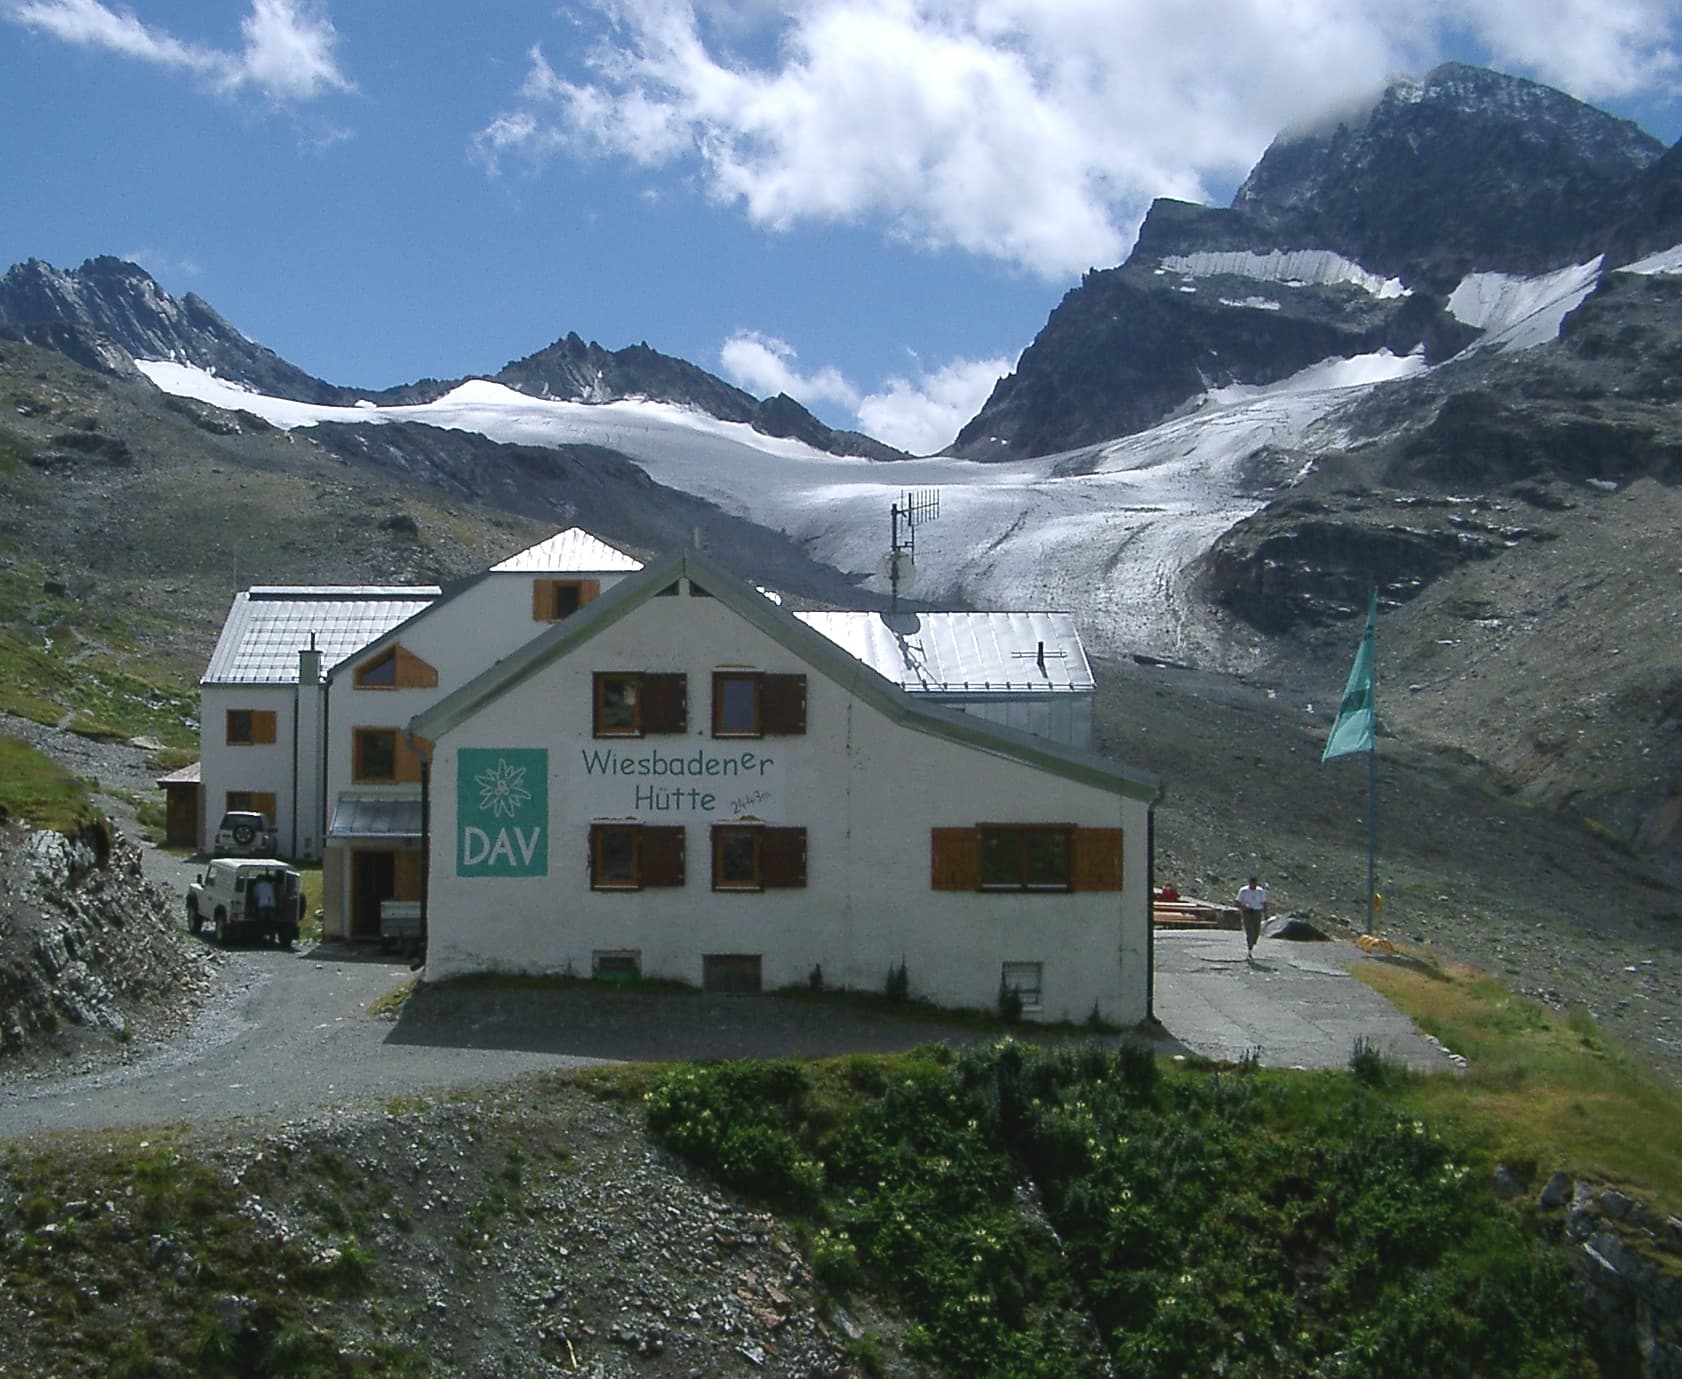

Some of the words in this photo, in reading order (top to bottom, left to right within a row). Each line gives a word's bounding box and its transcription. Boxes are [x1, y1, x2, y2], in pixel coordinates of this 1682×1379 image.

[582, 749, 774, 776] Wiesbadener
[635, 785, 716, 811] Hütte
[464, 826, 541, 866] DAV
